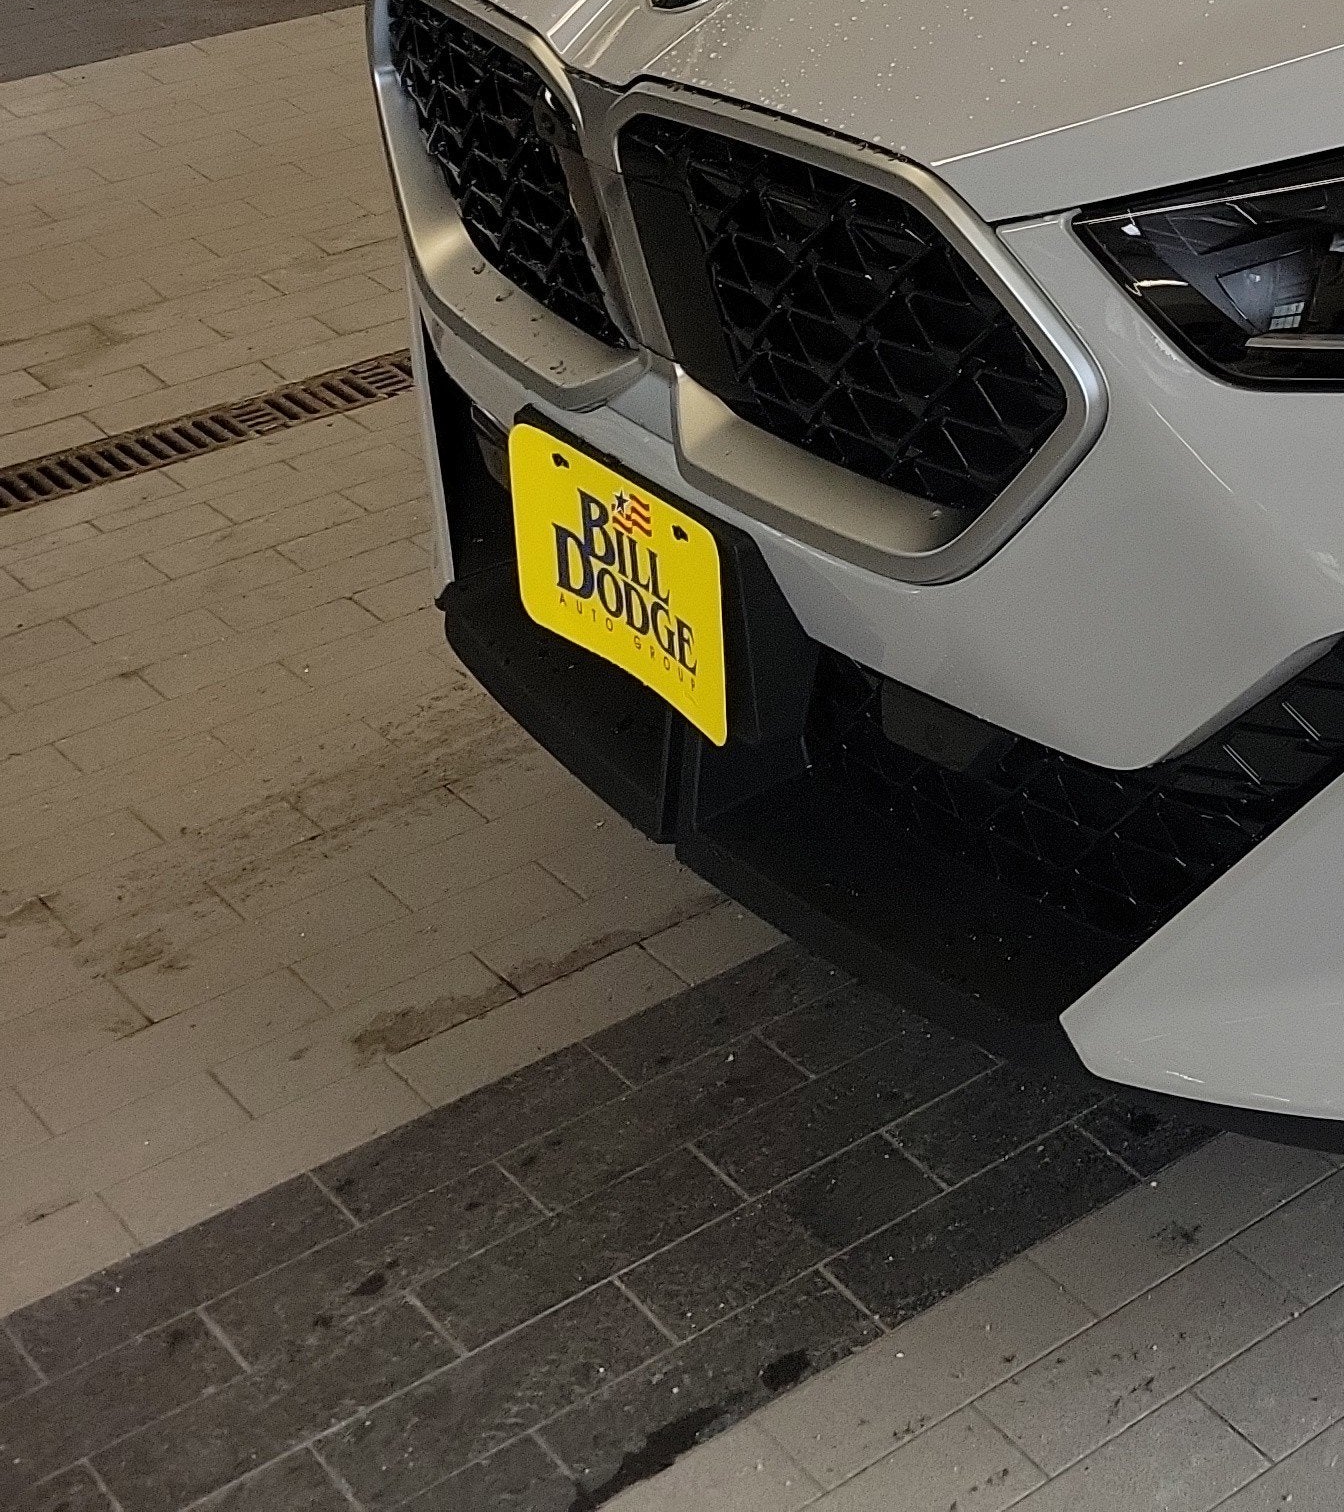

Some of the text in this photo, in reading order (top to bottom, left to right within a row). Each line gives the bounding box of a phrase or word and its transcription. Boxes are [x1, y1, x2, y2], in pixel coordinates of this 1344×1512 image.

[552, 523, 697, 677] DODGE
[577, 488, 670, 605] BILL
[559, 594, 698, 692] AUTO GROUP
